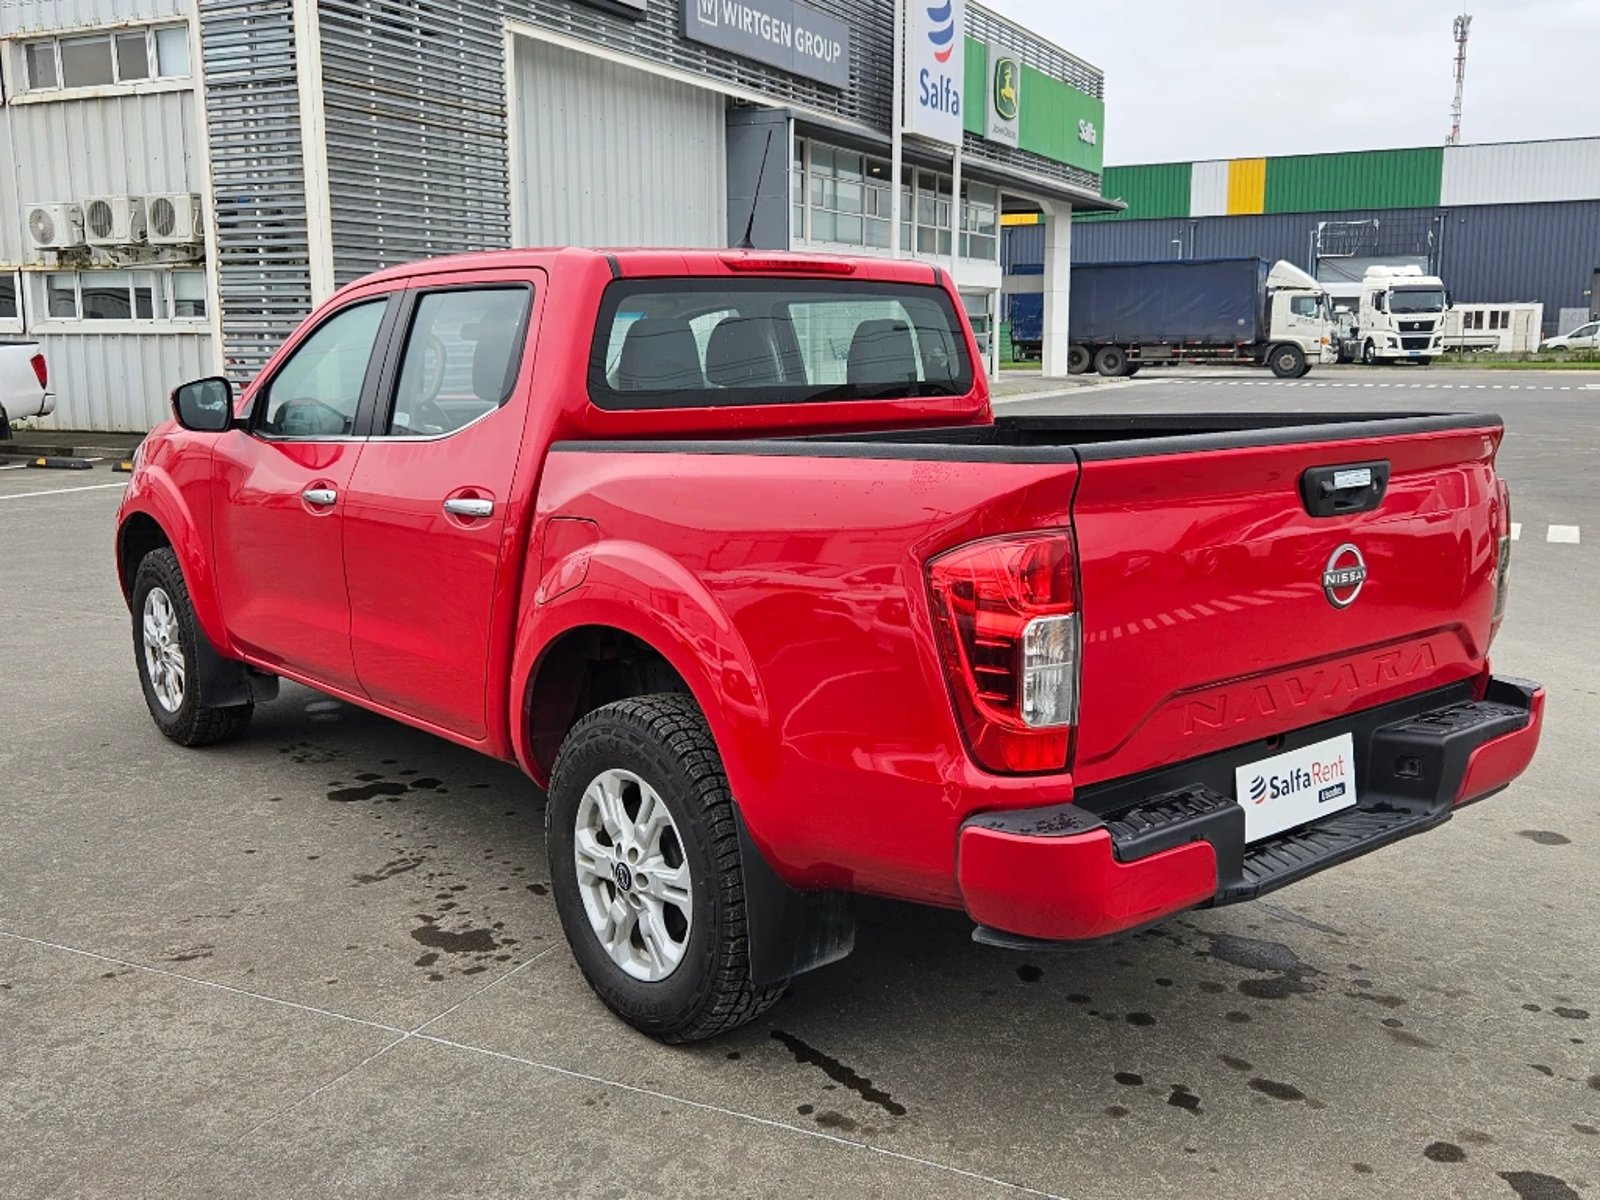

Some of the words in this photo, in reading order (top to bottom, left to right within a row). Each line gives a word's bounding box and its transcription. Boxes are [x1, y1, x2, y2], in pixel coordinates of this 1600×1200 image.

[722, 0, 792, 48] WIRTGEN
[794, 27, 842, 64] GROUP
[919, 67, 960, 117] Salfa
[1183, 642, 1437, 736] NAVARA
[1269, 754, 1345, 800] SalfaRent
